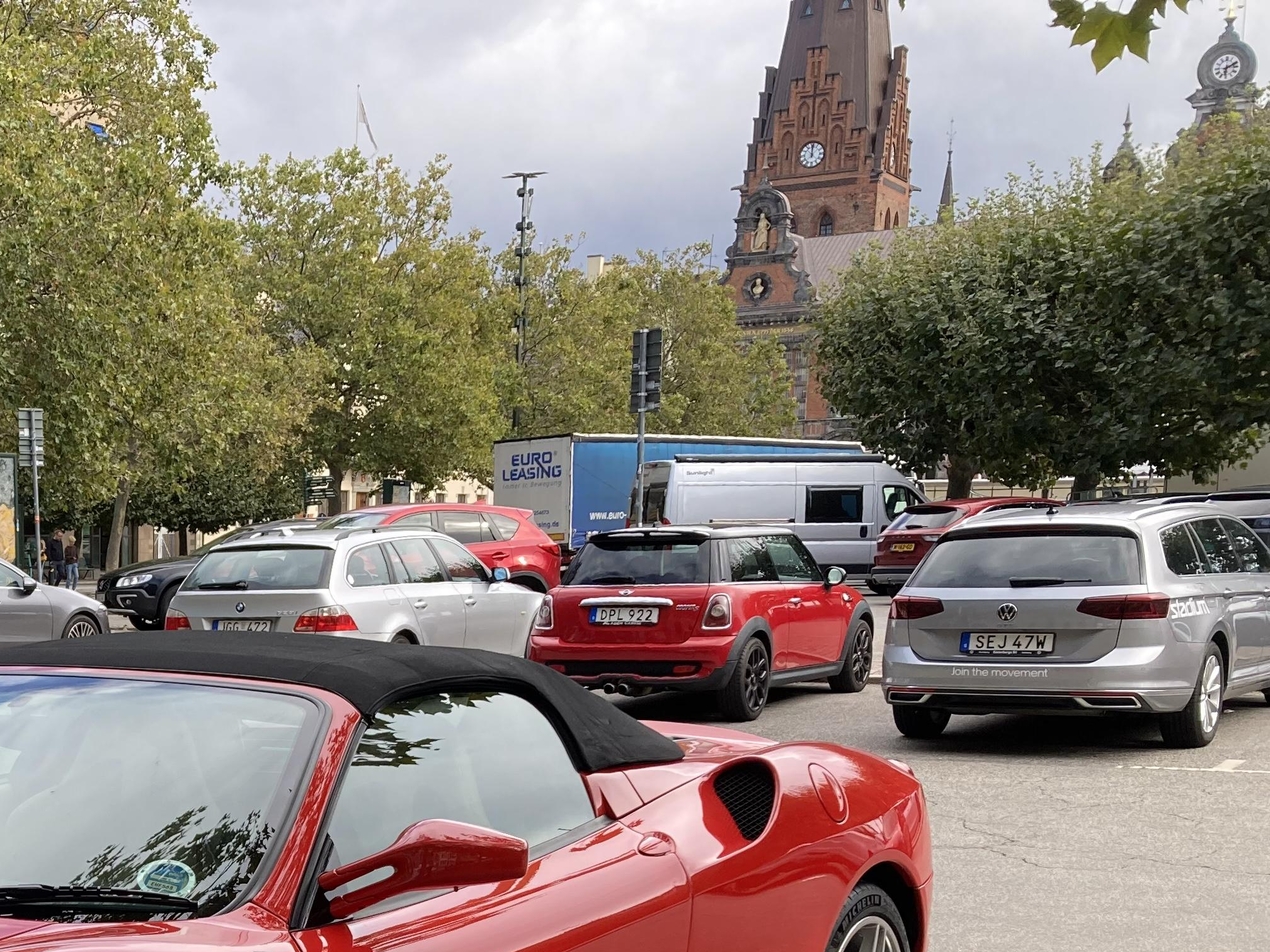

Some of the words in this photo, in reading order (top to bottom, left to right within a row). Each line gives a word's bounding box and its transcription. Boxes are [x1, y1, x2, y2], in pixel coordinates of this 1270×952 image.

[512, 451, 552, 466] EURO
[503, 465, 561, 481] LEASING
[600, 609, 623, 620] DPL
[629, 609, 653, 621] 922
[247, 621, 268, 632] 472
[975, 635, 1007, 649] SEJ
[1013, 635, 1047, 649] 47W
[951, 667, 970, 676] Join
[972, 668, 989, 677] the
[991, 668, 1048, 678] movement
[842, 894, 881, 931] MICHELIN
